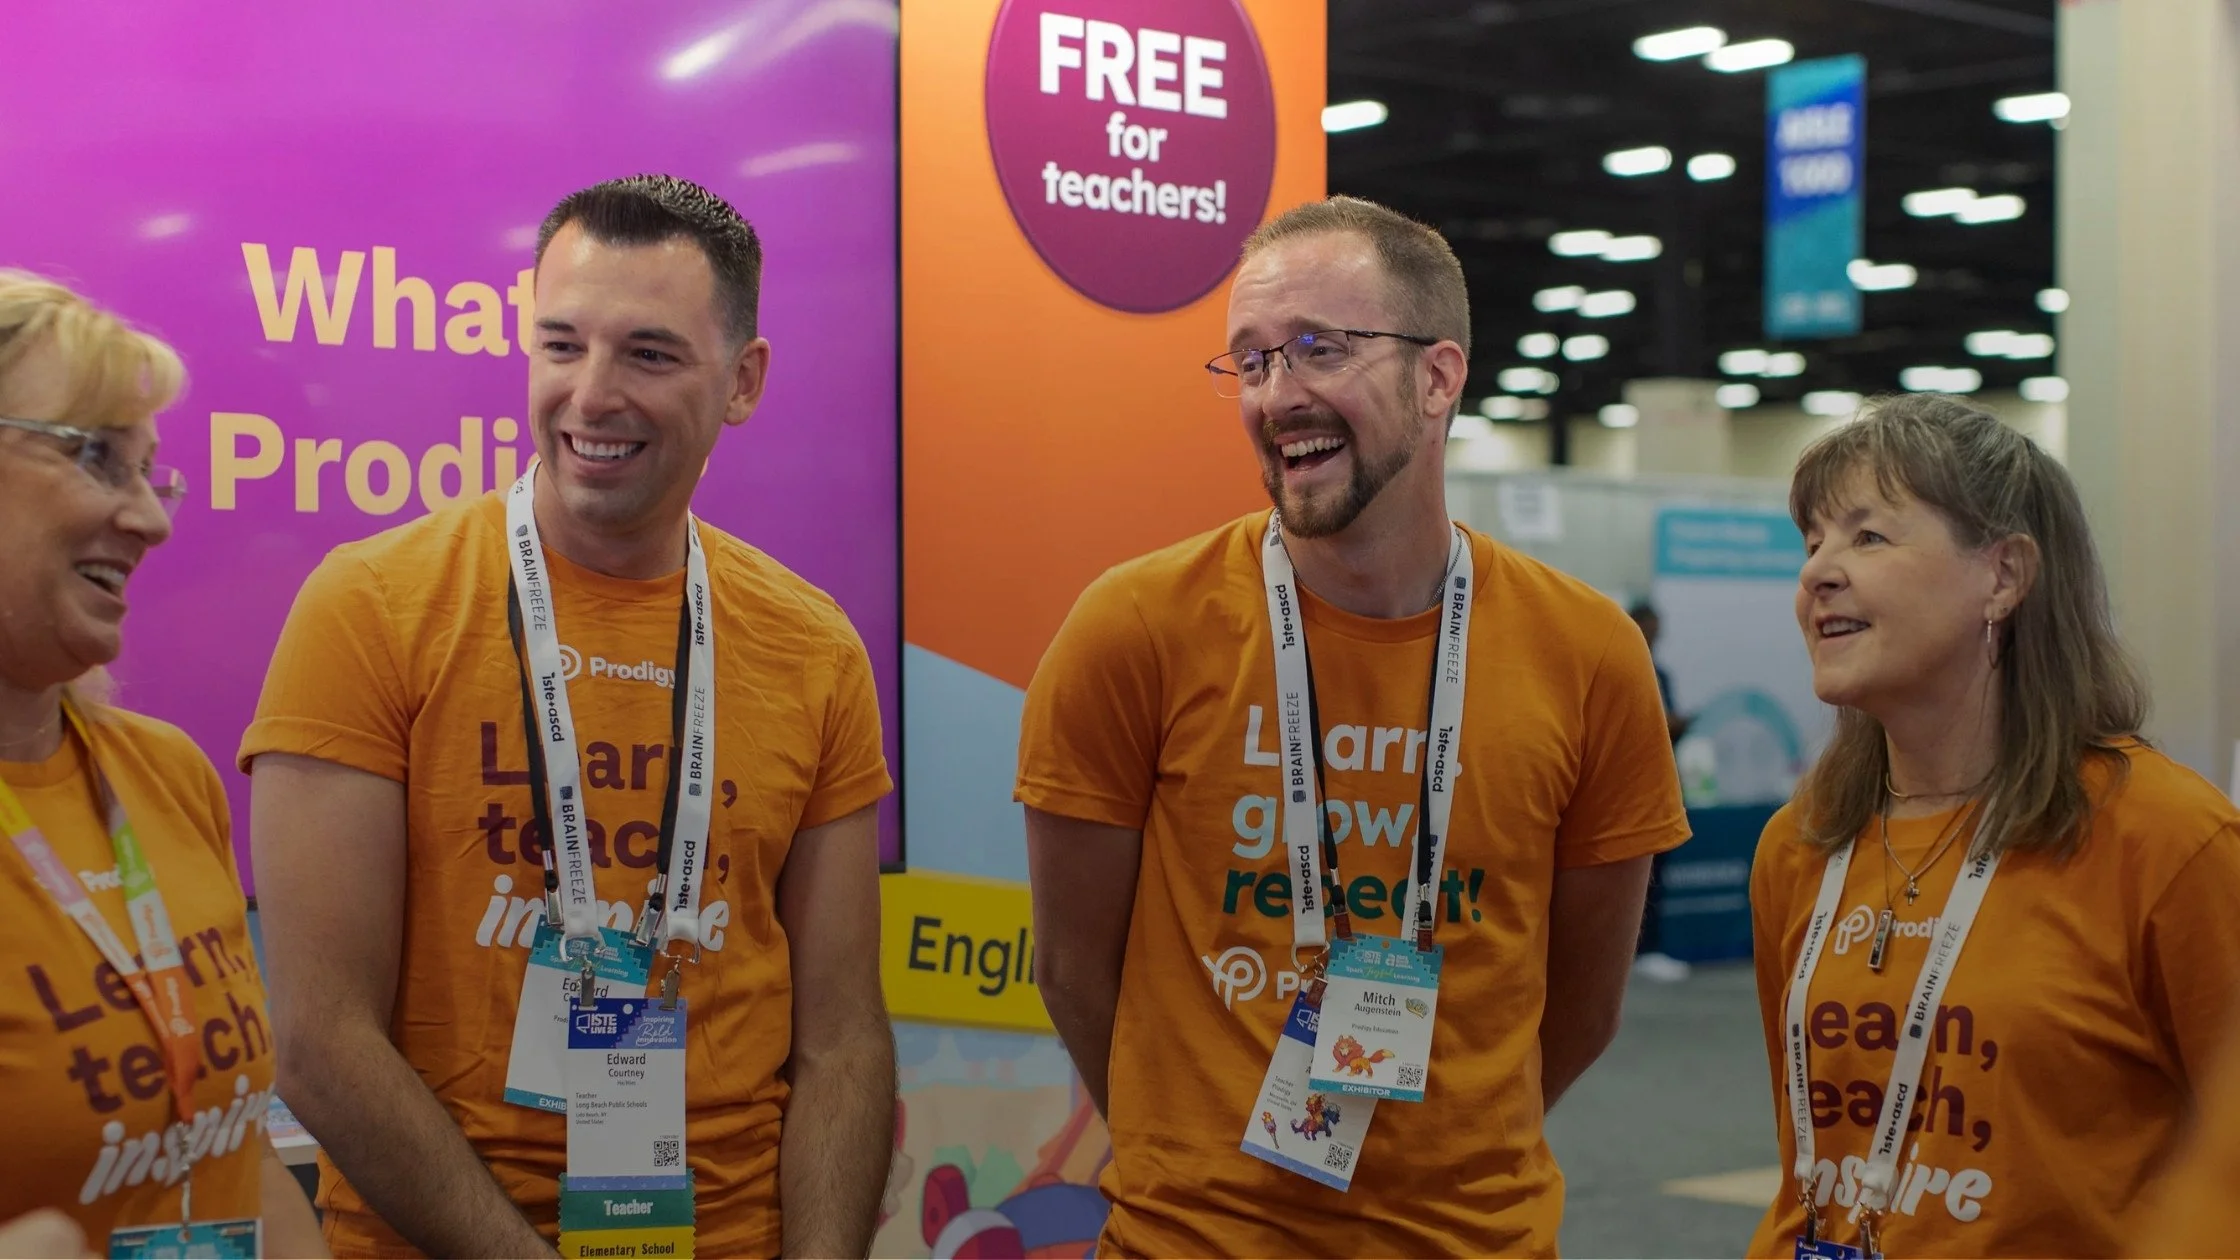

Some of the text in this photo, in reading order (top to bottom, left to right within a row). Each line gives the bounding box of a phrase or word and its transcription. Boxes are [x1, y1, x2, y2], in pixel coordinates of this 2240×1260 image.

[1040, 11, 1227, 118] FREE
[1106, 110, 1168, 162] for
[1041, 160, 1227, 225] teachers!
[209, 410, 541, 515] Prodi
[480, 721, 738, 809] Lar,
[26, 927, 247, 1033] Lern,
[1363, 991, 1396, 1007] Mitch
[1354, 1002, 1401, 1017] Augenstein
[590, 1013, 618, 1026] ISTE
[607, 1052, 647, 1065] Edward
[608, 1068, 645, 1080] Courtney
[1342, 1084, 1391, 1096] EXHIBITOR
[626, 1100, 648, 1108] Schools
[603, 1199, 654, 1216] Teacher
[580, 1242, 675, 1258] Elementary School
